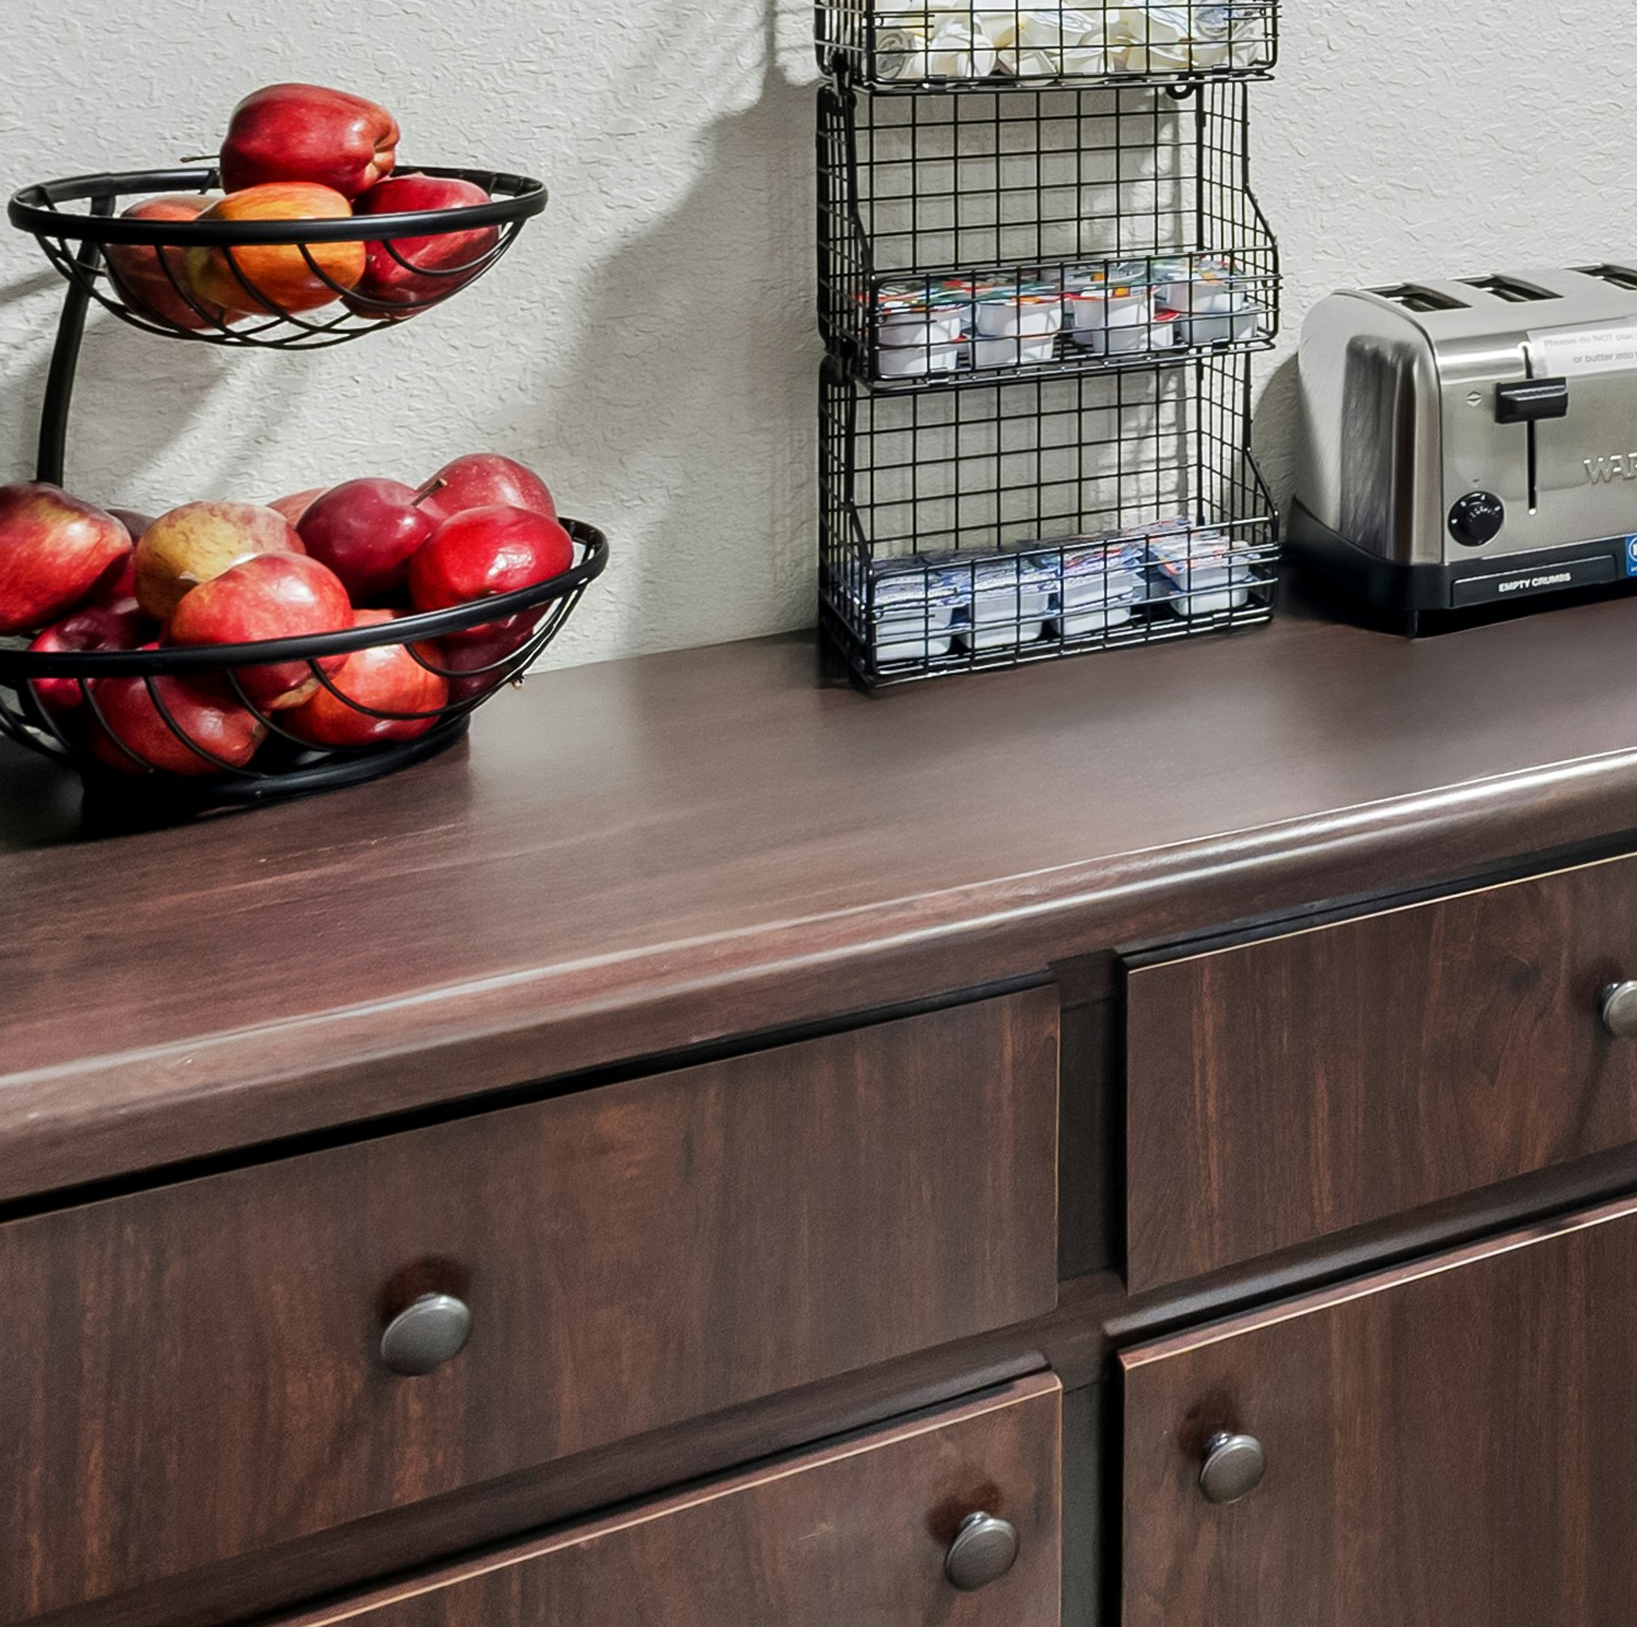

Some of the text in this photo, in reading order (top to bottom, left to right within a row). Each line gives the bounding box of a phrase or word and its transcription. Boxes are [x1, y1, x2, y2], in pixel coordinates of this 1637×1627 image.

[1579, 336, 1591, 344] do
[1592, 333, 1613, 343] NOT
[1573, 356, 1583, 364] or
[1585, 352, 1613, 363] butter
[1615, 350, 1634, 360] into
[1499, 573, 1571, 592] EMPTY CRUMBS
